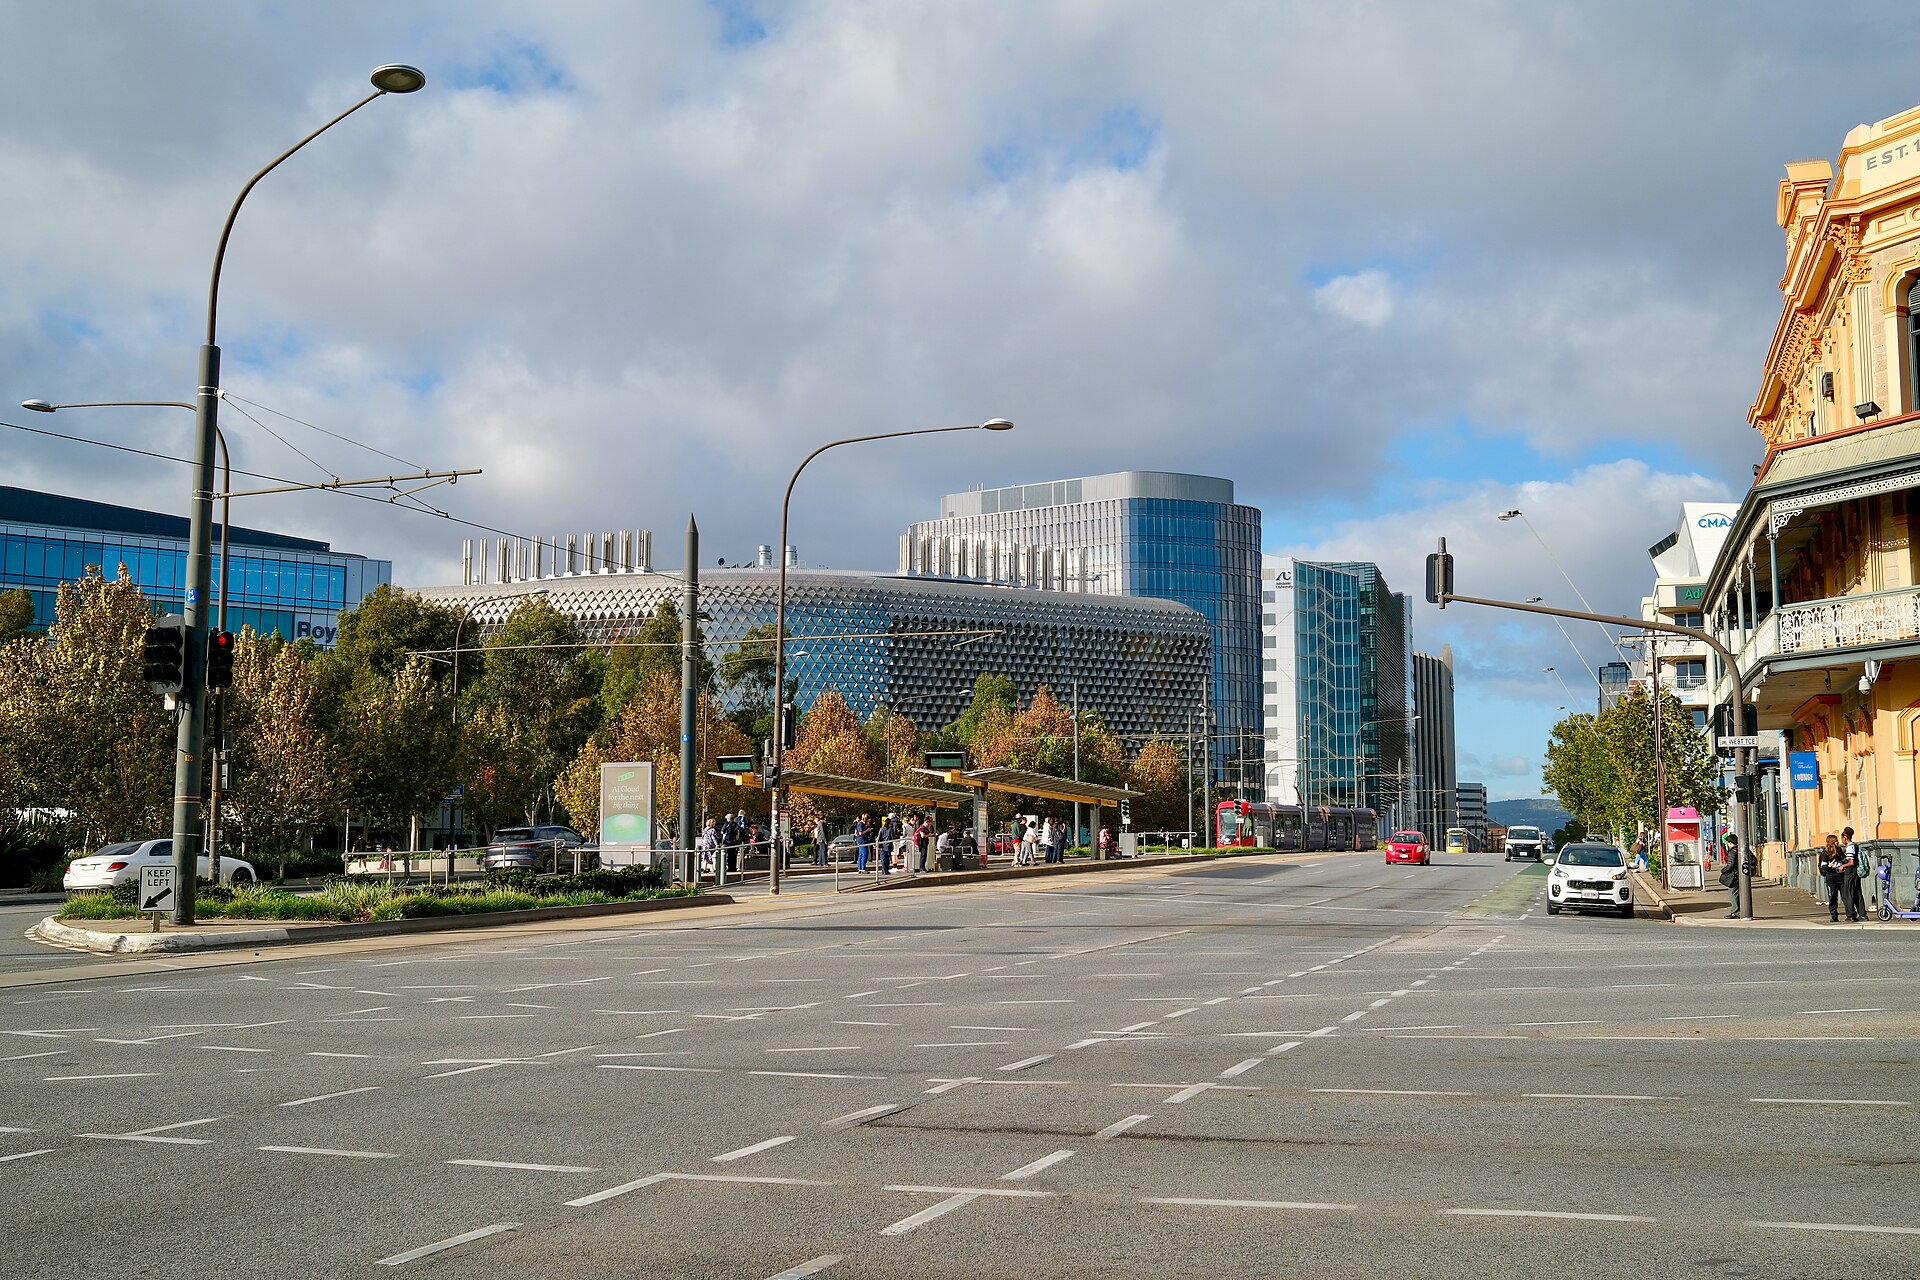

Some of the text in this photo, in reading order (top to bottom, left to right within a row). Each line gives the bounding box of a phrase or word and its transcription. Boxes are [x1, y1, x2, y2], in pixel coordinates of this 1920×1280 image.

[1867, 144, 1908, 170] EST.
[1698, 518, 1734, 528] CMA
[298, 621, 338, 643] Roy
[1794, 773, 1814, 781] LOUNGE
[620, 785, 640, 793] Cloud
[613, 802, 640, 810] big thing
[147, 869, 171, 878] KEEP
[147, 879, 170, 887] LEFT
